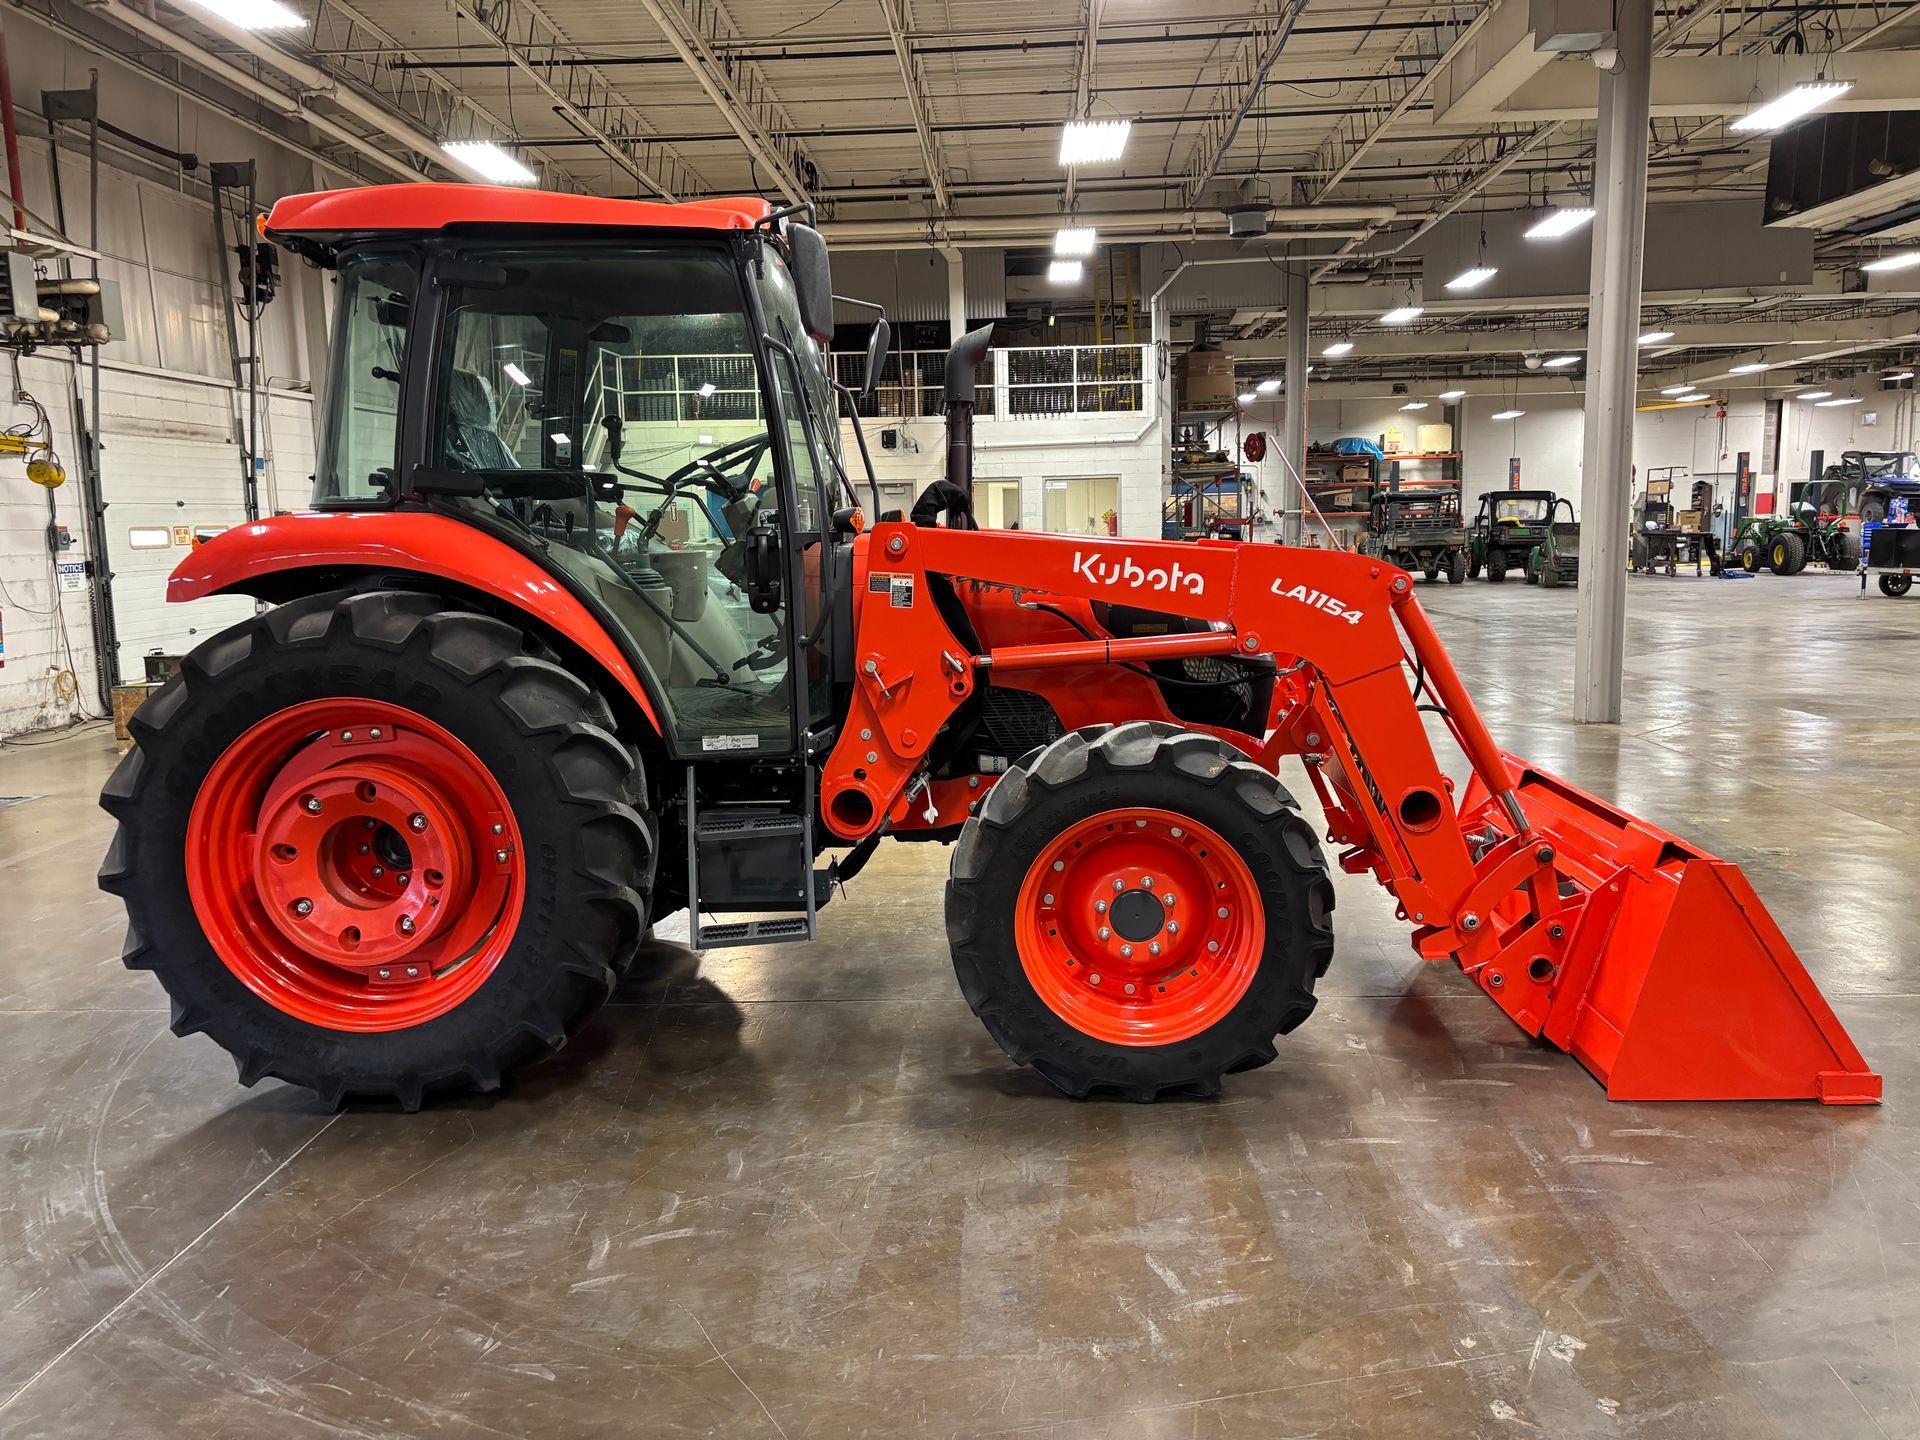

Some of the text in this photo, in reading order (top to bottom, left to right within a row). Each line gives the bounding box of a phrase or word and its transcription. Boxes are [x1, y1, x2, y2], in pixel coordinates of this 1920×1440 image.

[59, 564, 84, 573] NOTICE
[1073, 552, 1205, 595] Kubota
[1270, 578, 1364, 625] LA1154
